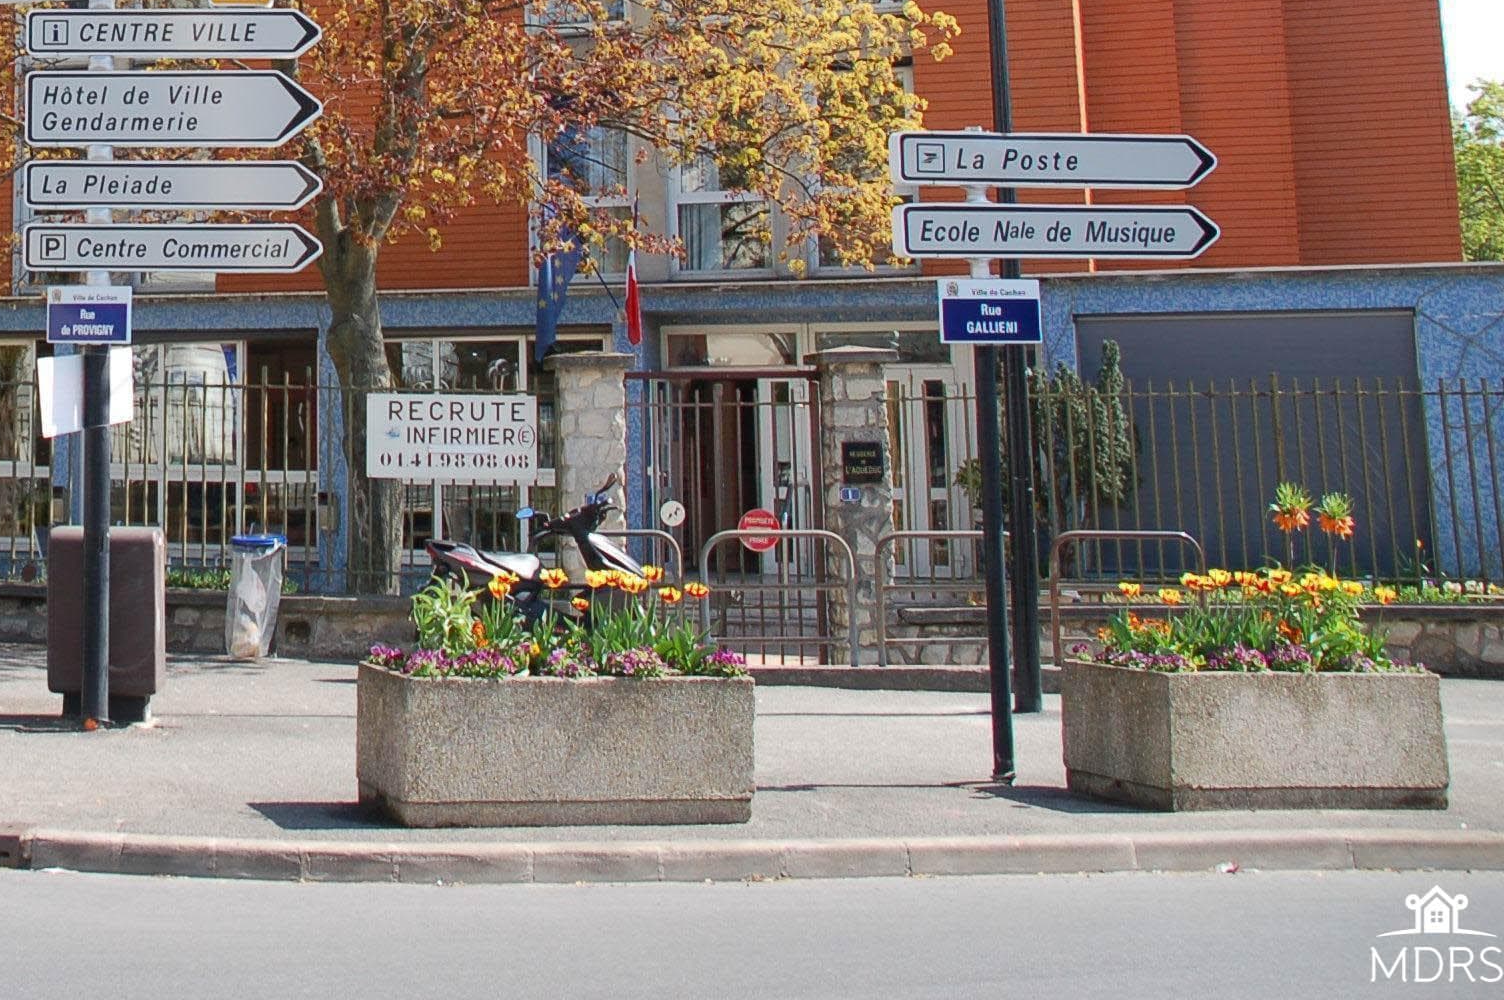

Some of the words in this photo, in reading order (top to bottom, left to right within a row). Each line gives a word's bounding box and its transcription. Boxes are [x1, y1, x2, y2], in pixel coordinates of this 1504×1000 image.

[79, 23, 174, 42] CENTRE
[191, 23, 257, 42] VILLE
[43, 85, 108, 105] Hôtel
[123, 86, 150, 105] de
[168, 85, 223, 105] Ville
[42, 112, 198, 132] Gendarmerie
[957, 148, 985, 170] La
[1002, 148, 1079, 171] Poste
[42, 175, 67, 195] La
[83, 175, 173, 195] Pleiade
[920, 220, 980, 243] Ecole
[994, 221, 1035, 243] Nale
[1046, 221, 1072, 243] de
[1085, 221, 1176, 247] Musique
[44, 238, 61, 257] P
[76, 239, 147, 257] Centre
[162, 238, 289, 258] Commercial
[80, 308, 95, 319] Rue
[981, 303, 1002, 316] Rue
[61, 324, 71, 335] de
[73, 324, 114, 336] PROVIGNY
[967, 321, 1017, 333] GALLIENI
[389, 401, 526, 422] RECRUTE
[407, 424, 535, 448] INFIRMIER(E)
